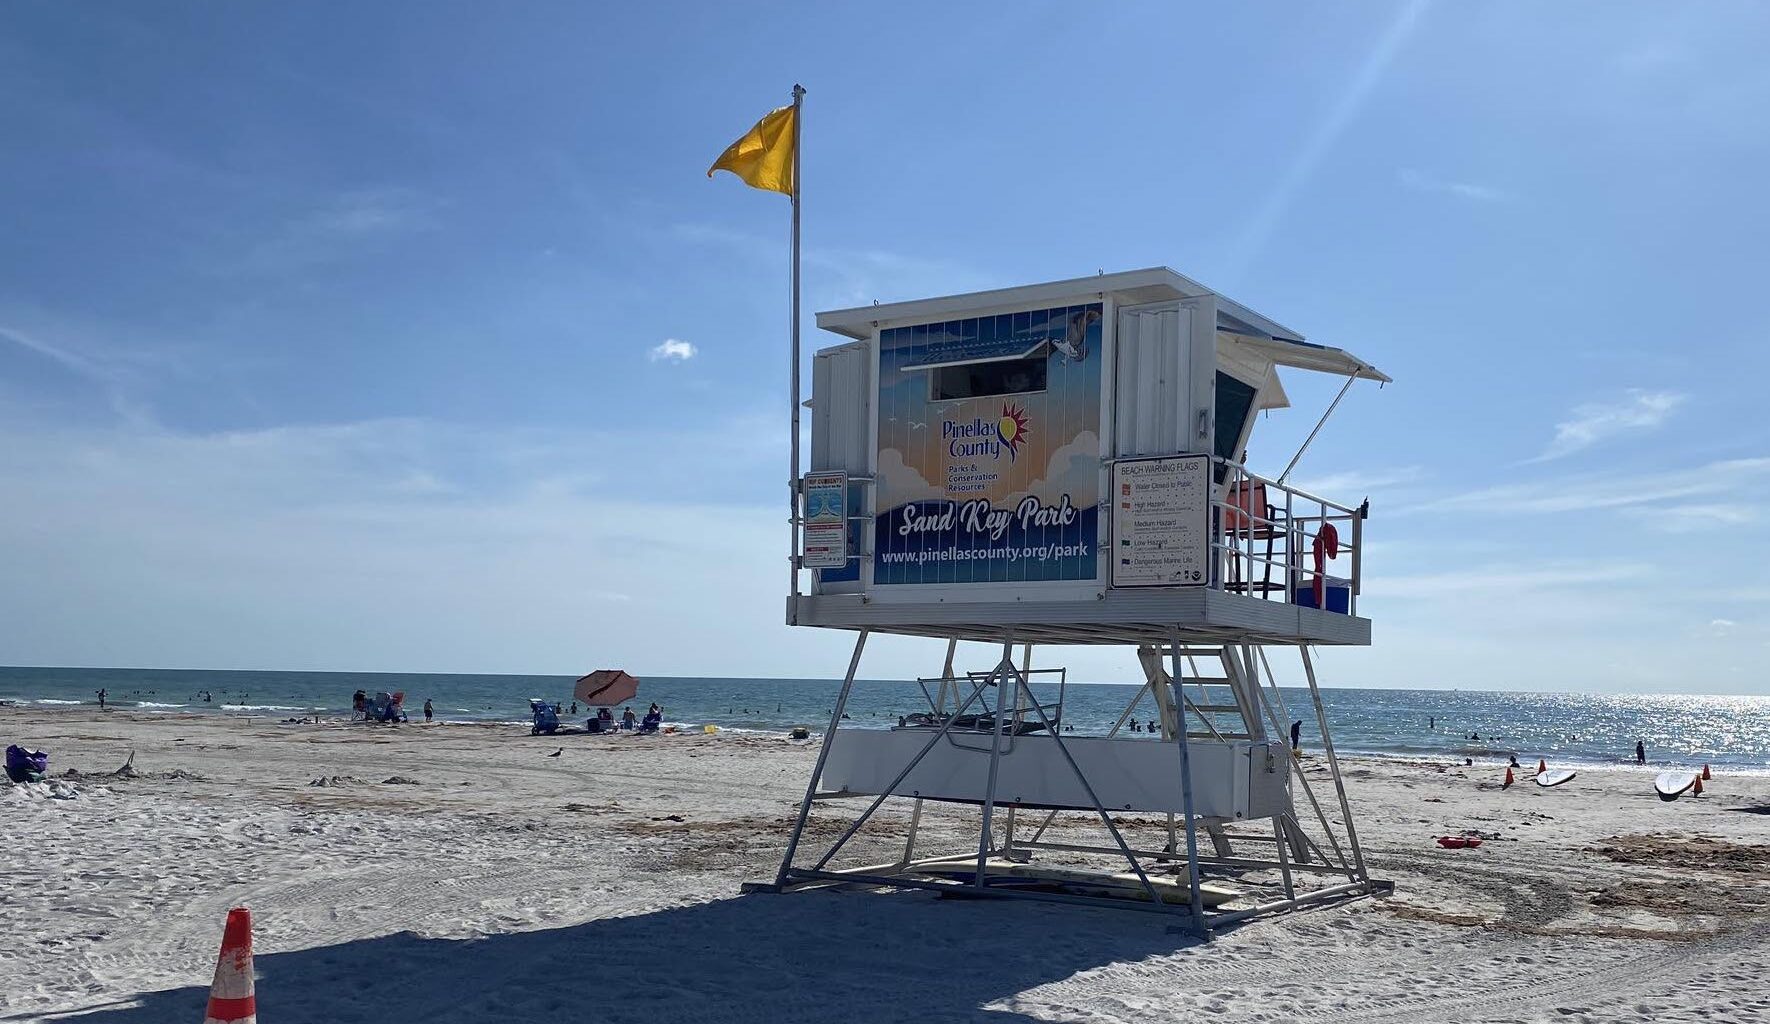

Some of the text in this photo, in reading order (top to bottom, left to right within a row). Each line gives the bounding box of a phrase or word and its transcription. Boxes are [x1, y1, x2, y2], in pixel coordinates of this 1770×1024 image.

[943, 418, 996, 439] Pinellas
[949, 439, 1000, 460] County
[948, 463, 977, 473] Parks &
[1121, 466, 1143, 475] BEACH
[1144, 463, 1175, 473] WARNING
[1176, 461, 1199, 471] FLAGS
[948, 473, 998, 482] Conservation
[948, 483, 985, 492] Resources
[1177, 480, 1193, 488] Public
[899, 494, 1077, 540] Sand Key Park
[882, 542, 1088, 565] www.pinellascounty.org/park
[1134, 558, 1163, 566] Dangerous
